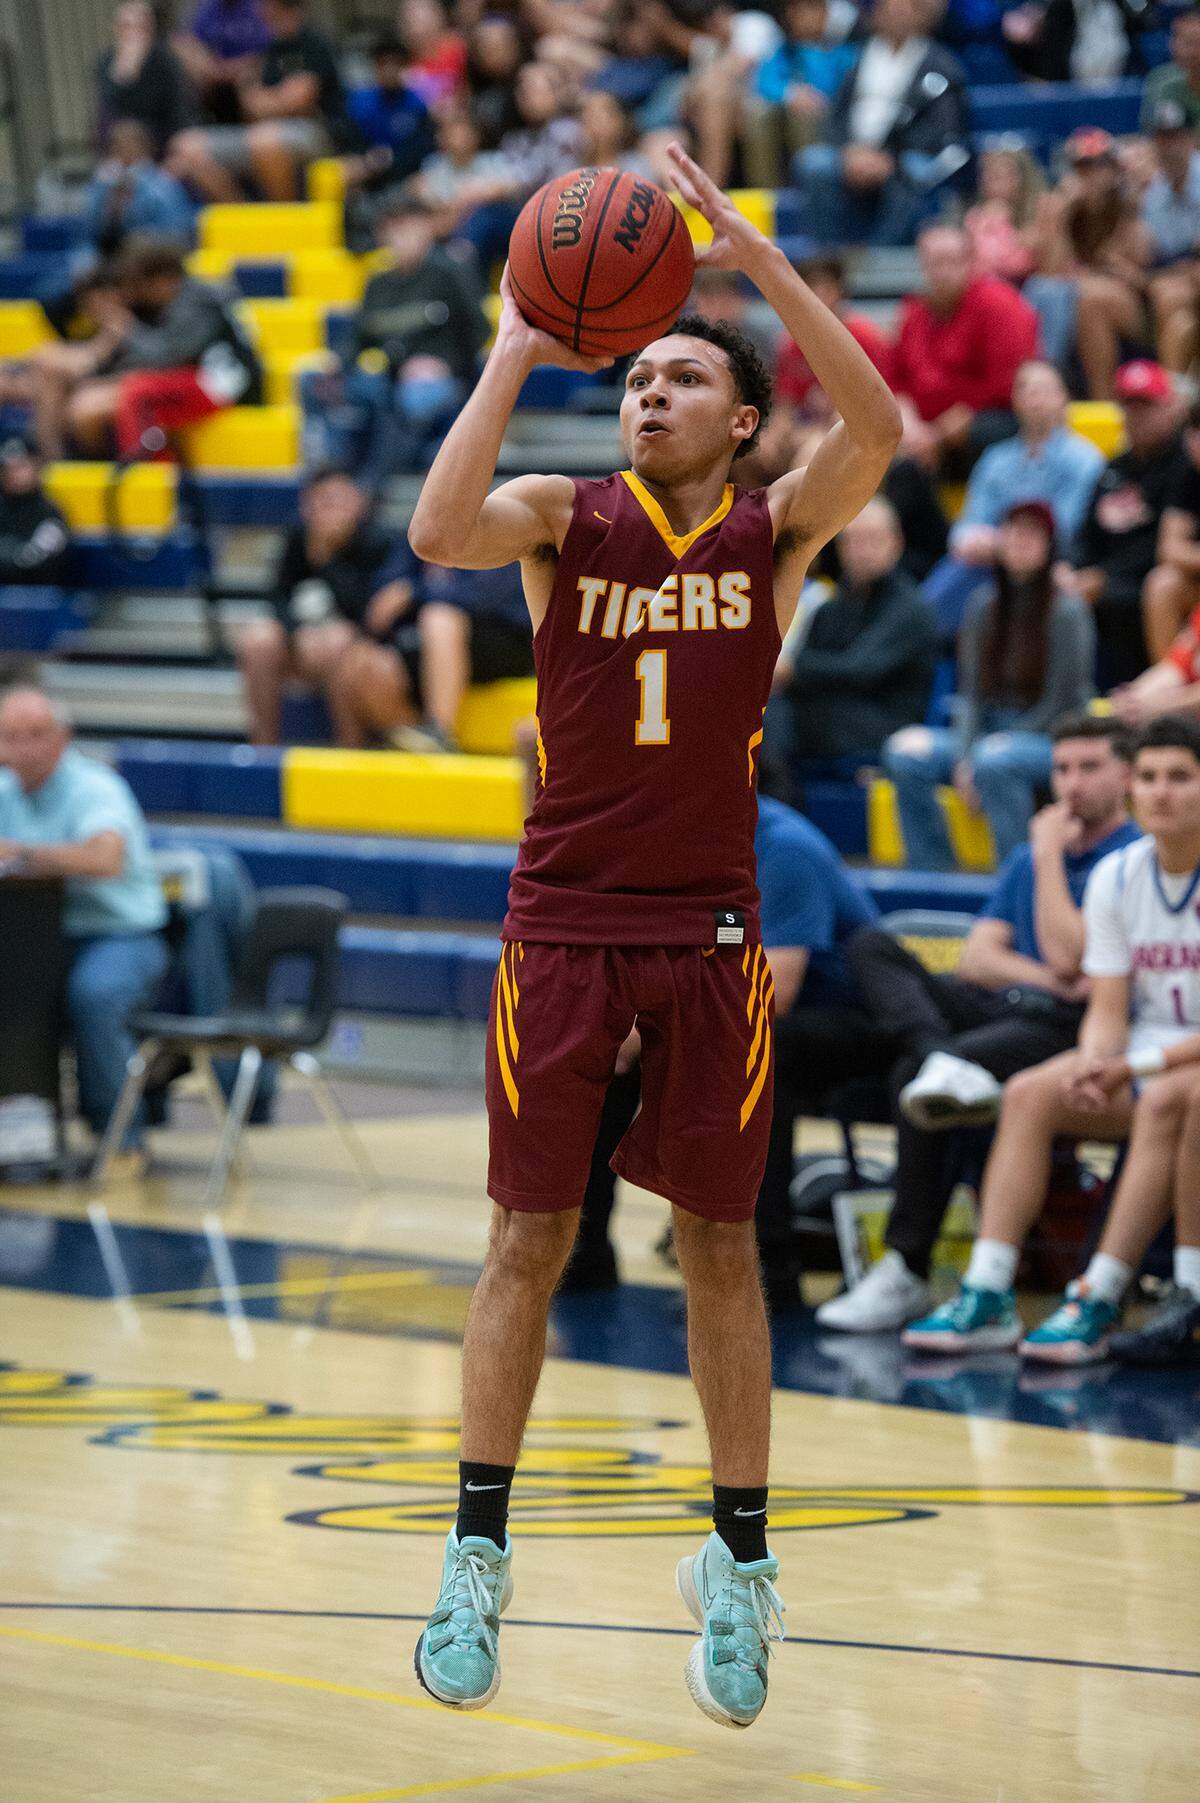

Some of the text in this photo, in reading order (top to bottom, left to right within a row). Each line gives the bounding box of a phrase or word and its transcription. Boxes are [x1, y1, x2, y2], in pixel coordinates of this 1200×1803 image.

[576, 571, 751, 639] TIGERS
[635, 649, 670, 745] 1
[725, 913, 736, 924] S
